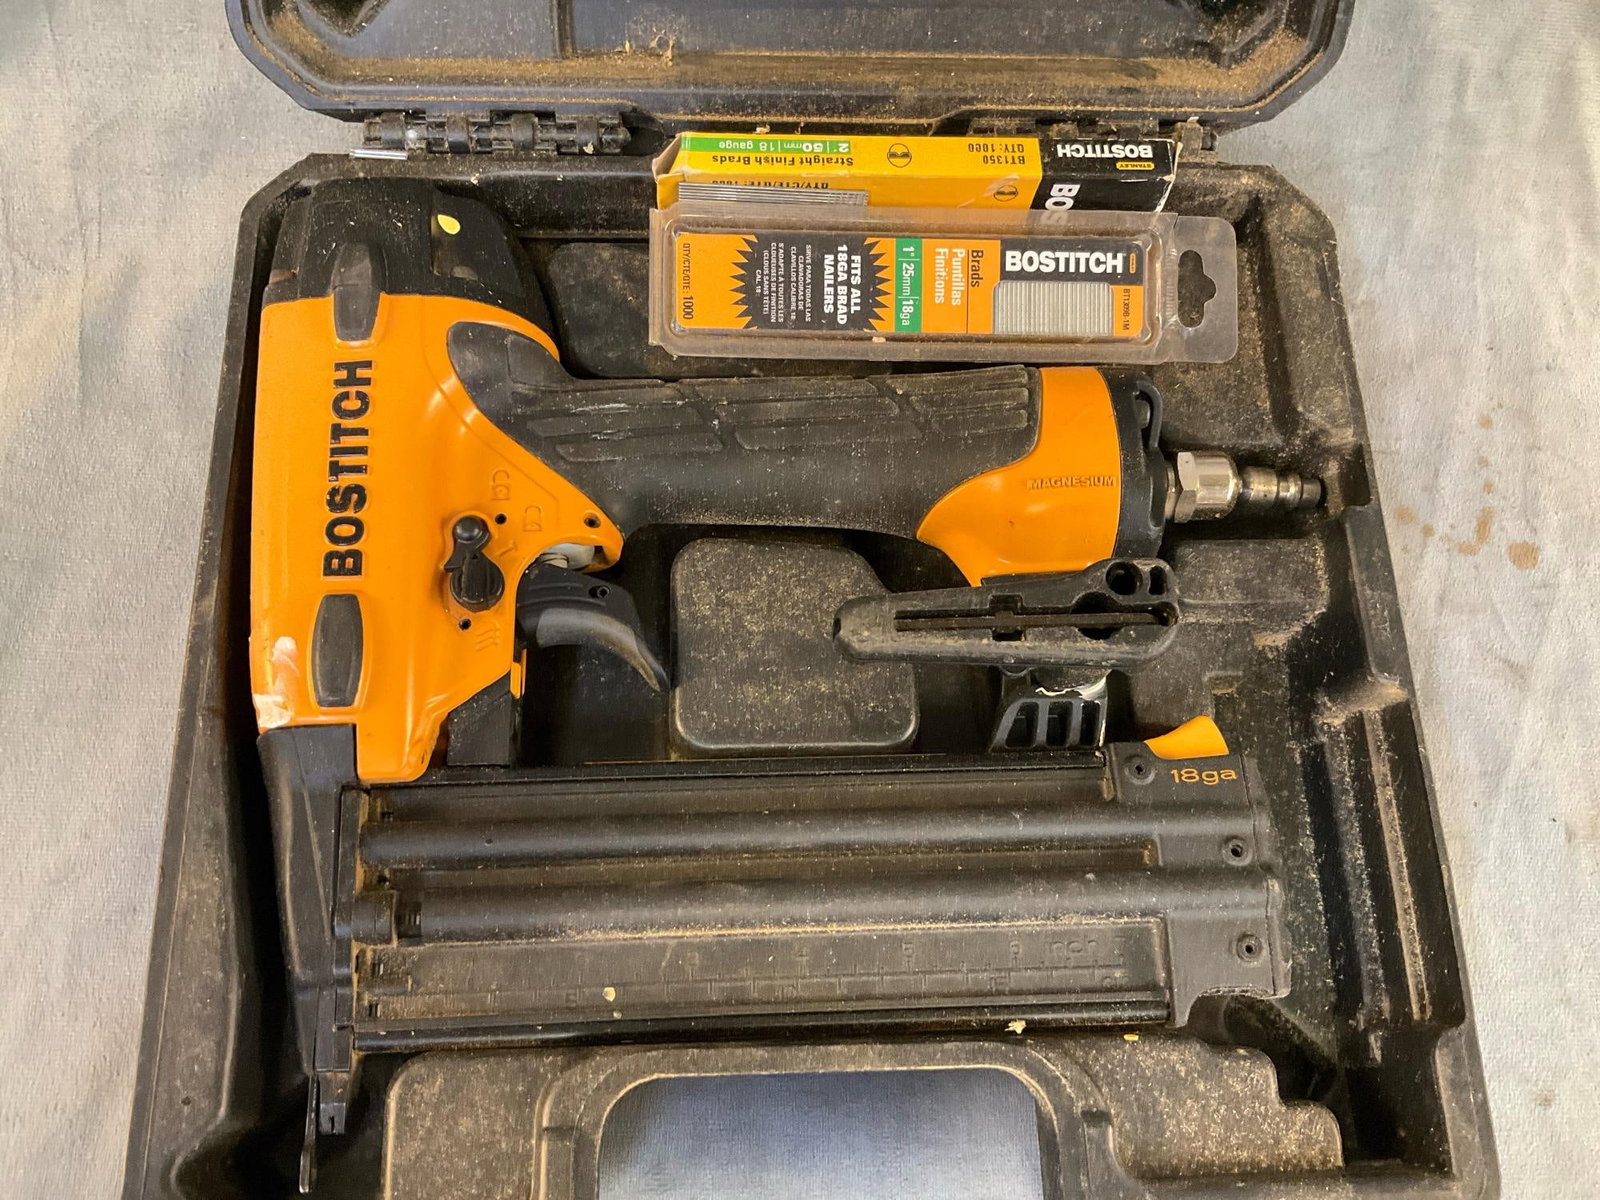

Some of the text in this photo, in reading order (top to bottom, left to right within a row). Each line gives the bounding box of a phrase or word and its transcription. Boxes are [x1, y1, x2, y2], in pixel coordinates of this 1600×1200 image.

[719, 140, 754, 149] gauge
[759, 142, 774, 151] 18
[784, 141, 823, 152] 50mm
[1000, 143, 1024, 153] QTY:
[1057, 144, 1153, 158] BOSTITCH
[712, 154, 853, 166] Straight Finish Brads
[983, 155, 1025, 165] BT1350
[971, 250, 984, 288] Brads
[1005, 250, 1123, 274] BOSTITCH
[823, 254, 835, 314] NAILERS
[837, 244, 848, 325] 18GA BRAD
[850, 255, 861, 314] FITS ALL
[902, 262, 915, 296] 25mm
[934, 247, 949, 304] Finitions
[951, 248, 965, 306] Puntillas
[683, 295, 694, 320] 1000
[900, 299, 914, 326] 18ga
[322, 360, 373, 578] BOSTITCH
[1026, 476, 1117, 490] MAGNESIUM
[1170, 768, 1238, 786] 18ga
